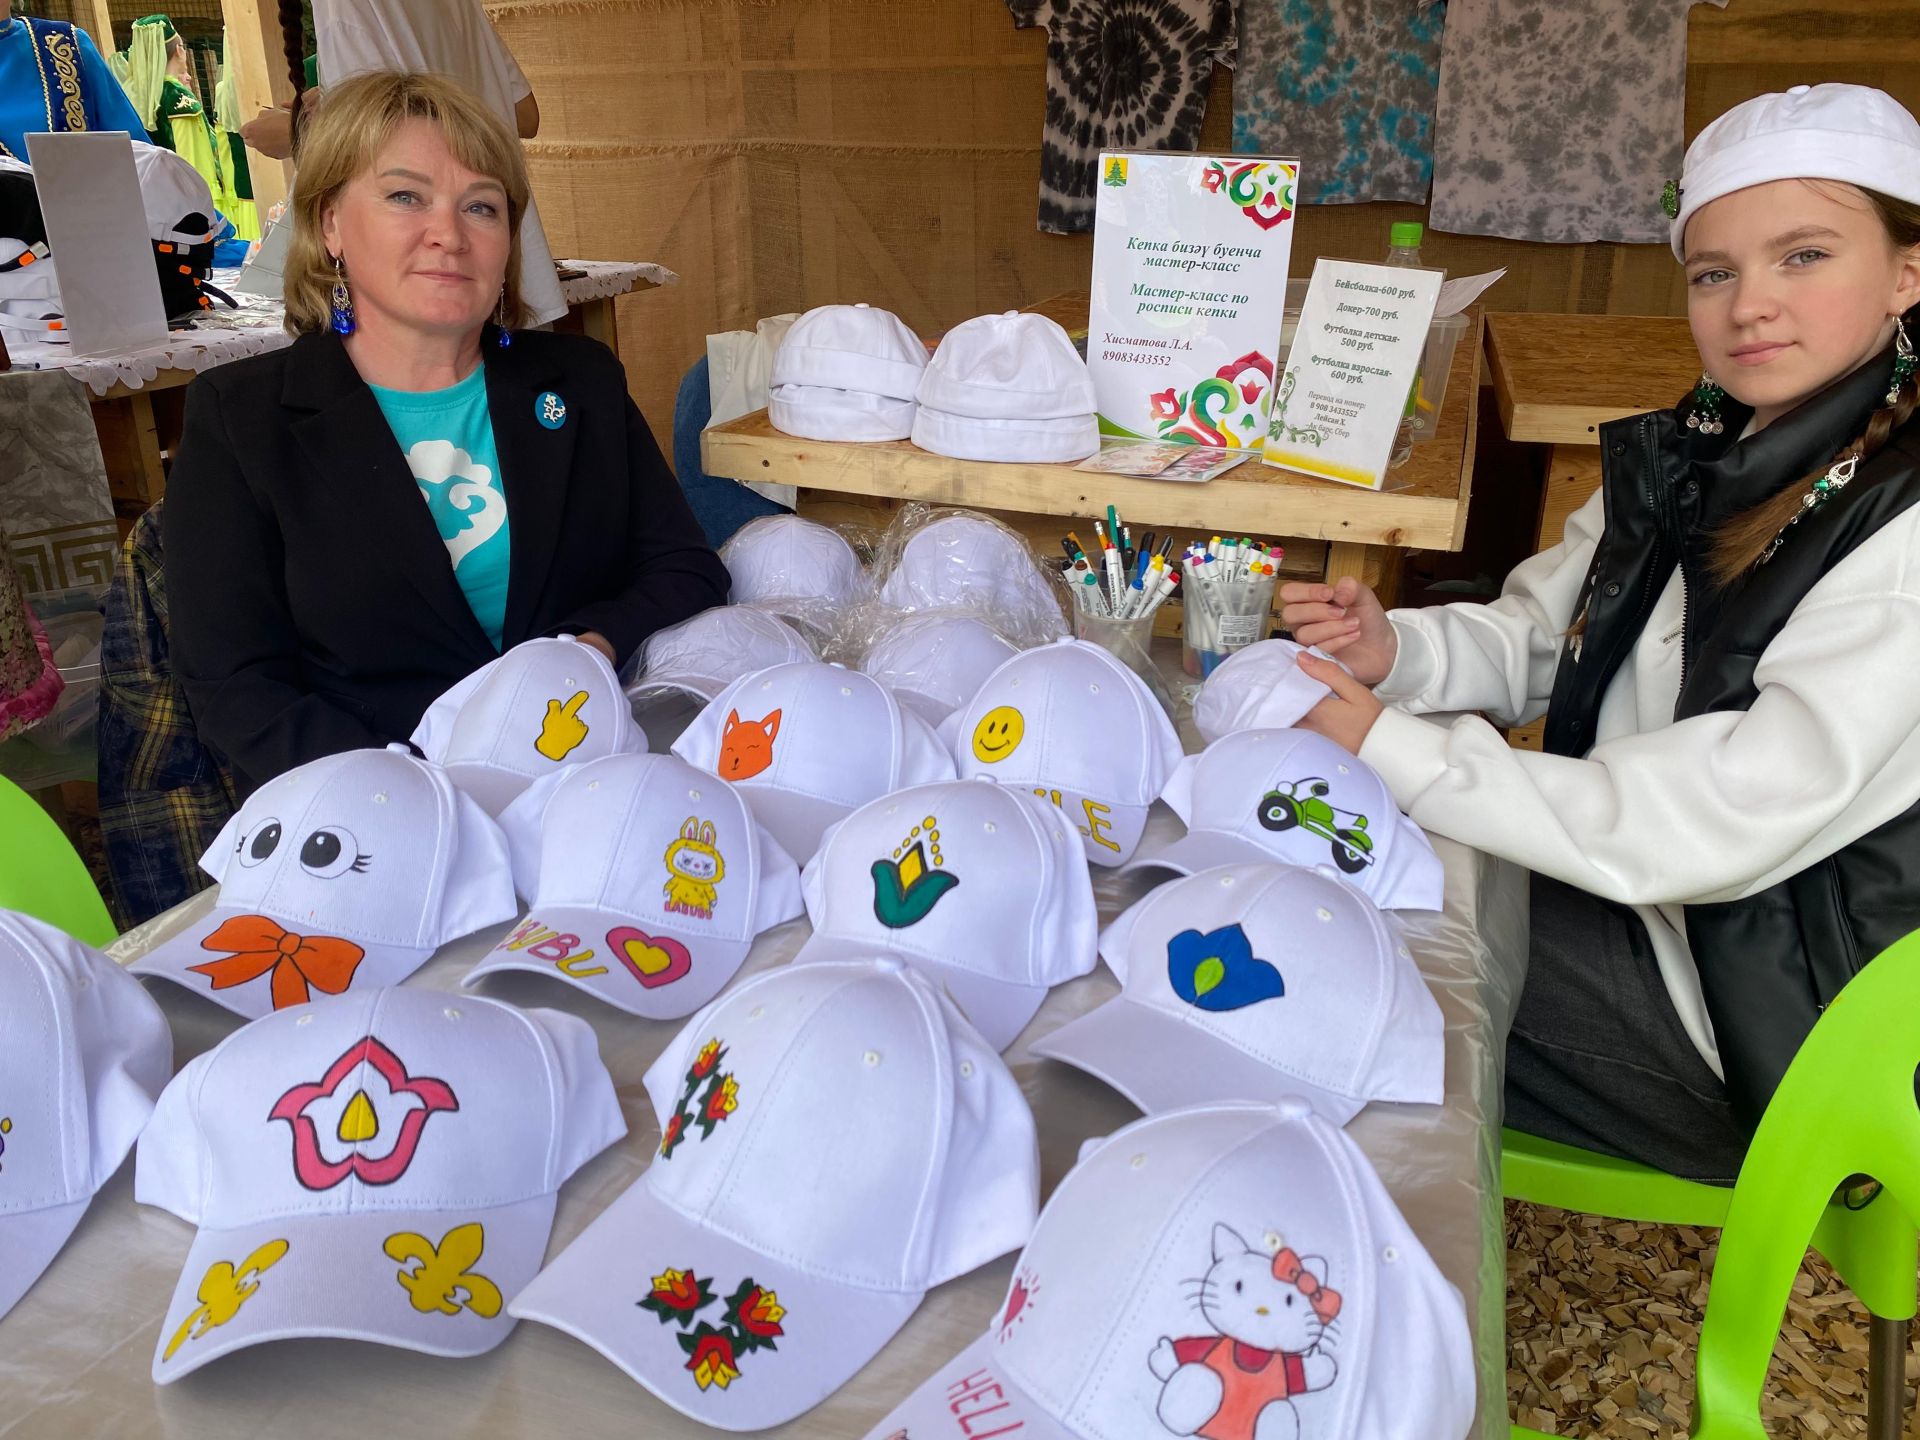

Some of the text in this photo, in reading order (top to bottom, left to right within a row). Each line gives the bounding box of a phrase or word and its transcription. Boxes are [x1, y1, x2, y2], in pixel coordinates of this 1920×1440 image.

[1127, 237, 1261, 259] Кепка бизәү буенча
[1143, 258, 1240, 272] мастер-класс
[1130, 284, 1248, 304] Мастер-класс по
[1335, 279, 1415, 299] Бейсболка-600 руб.
[1136, 302, 1238, 319] росписи кепки
[1337, 303, 1399, 320] Докер-700 руб.
[1103, 332, 1192, 350] Хисматова Л.А.
[1323, 323, 1400, 343] Футболка детская-
[1341, 338, 1374, 351] 500 руб.
[1102, 350, 1171, 366] 89083433552
[1311, 355, 1392, 377] Футболка взрослая-
[1331, 370, 1363, 384] 600 руб.
[1308, 391, 1334, 403] Перевод
[1316, 404, 1328, 412] 908
[1329, 406, 1358, 417] 3433552
[1314, 414, 1339, 424] Лейсан
[1335, 428, 1350, 438] Сбер
